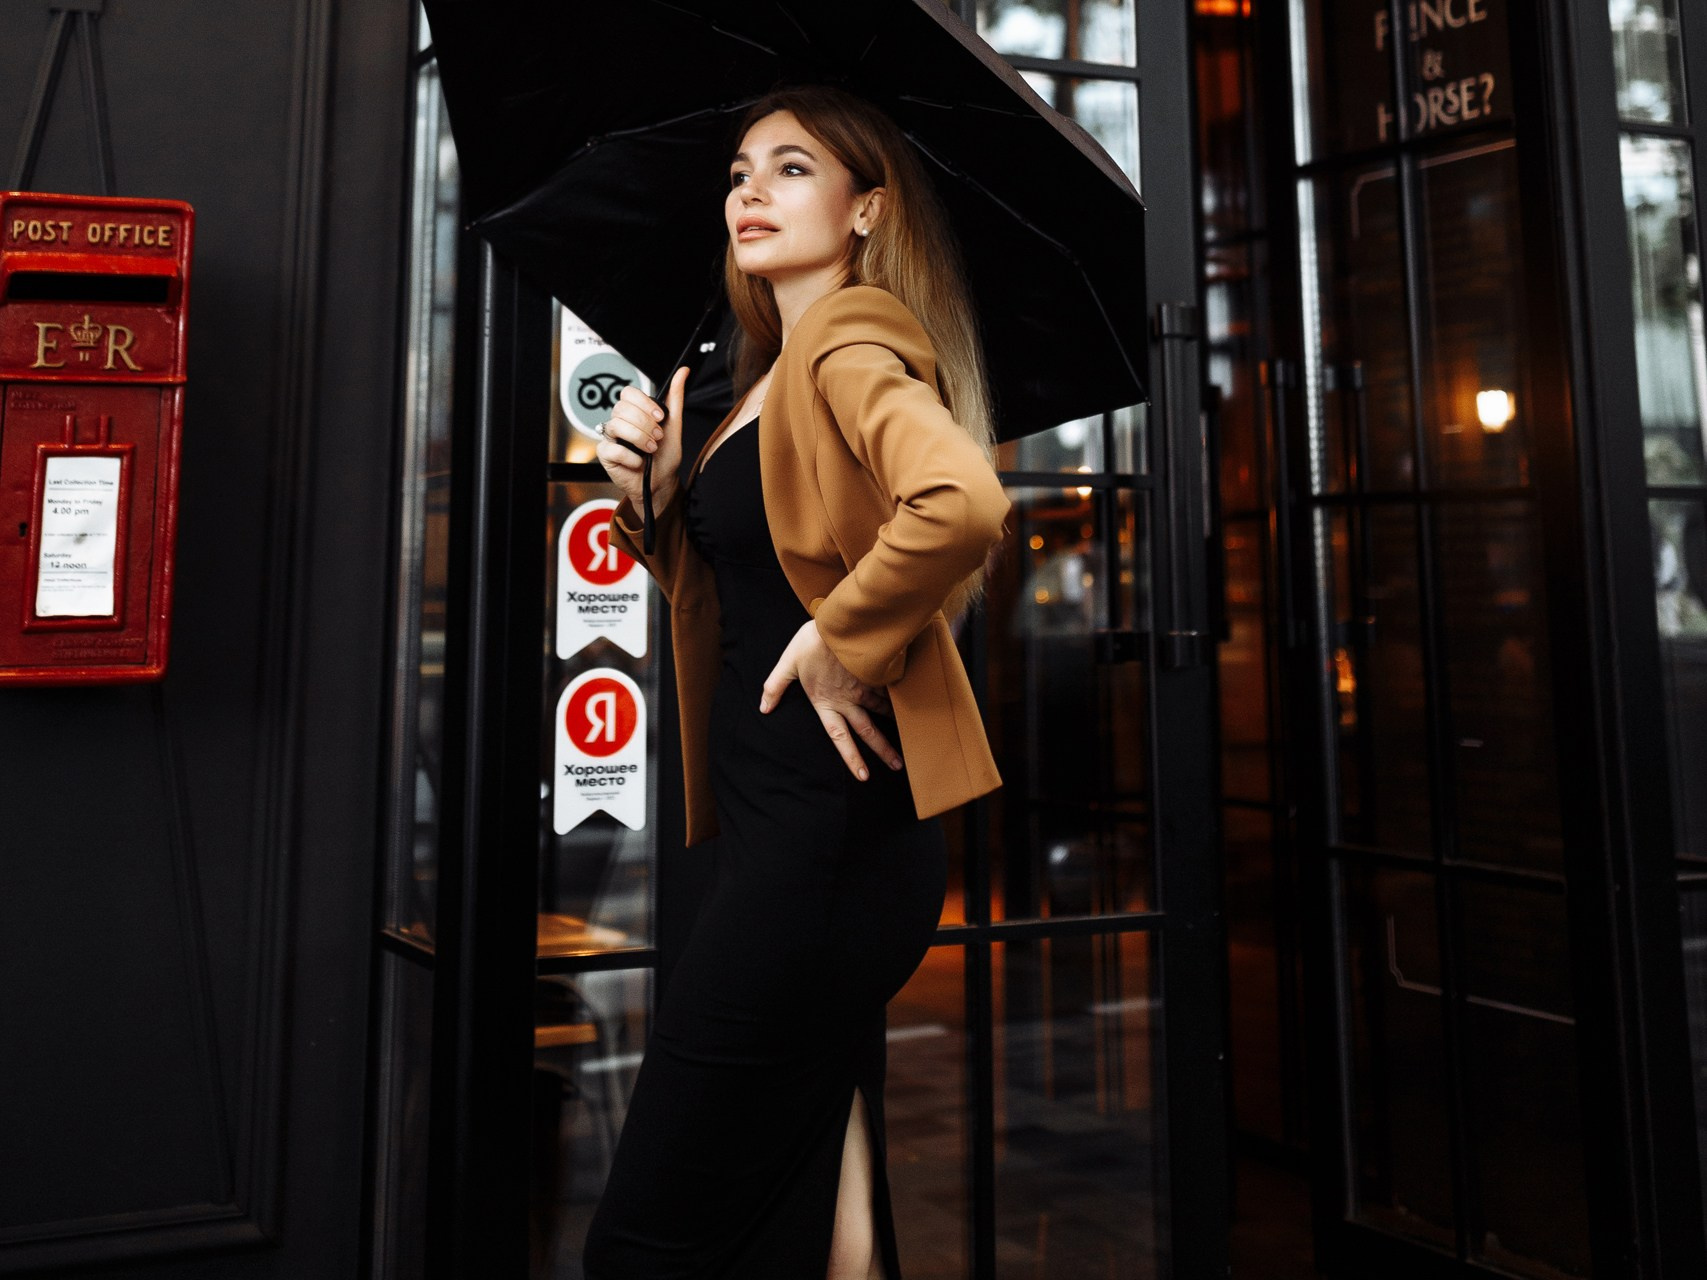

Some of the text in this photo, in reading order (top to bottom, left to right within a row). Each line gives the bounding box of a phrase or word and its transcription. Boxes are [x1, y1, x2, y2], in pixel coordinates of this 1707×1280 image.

[12, 219, 172, 247] POST OFFICE
[567, 591, 640, 604] Хорошее
[577, 604, 628, 614] место
[584, 691, 617, 743] Я
[564, 764, 638, 778] Хорошее
[575, 777, 626, 787] место
